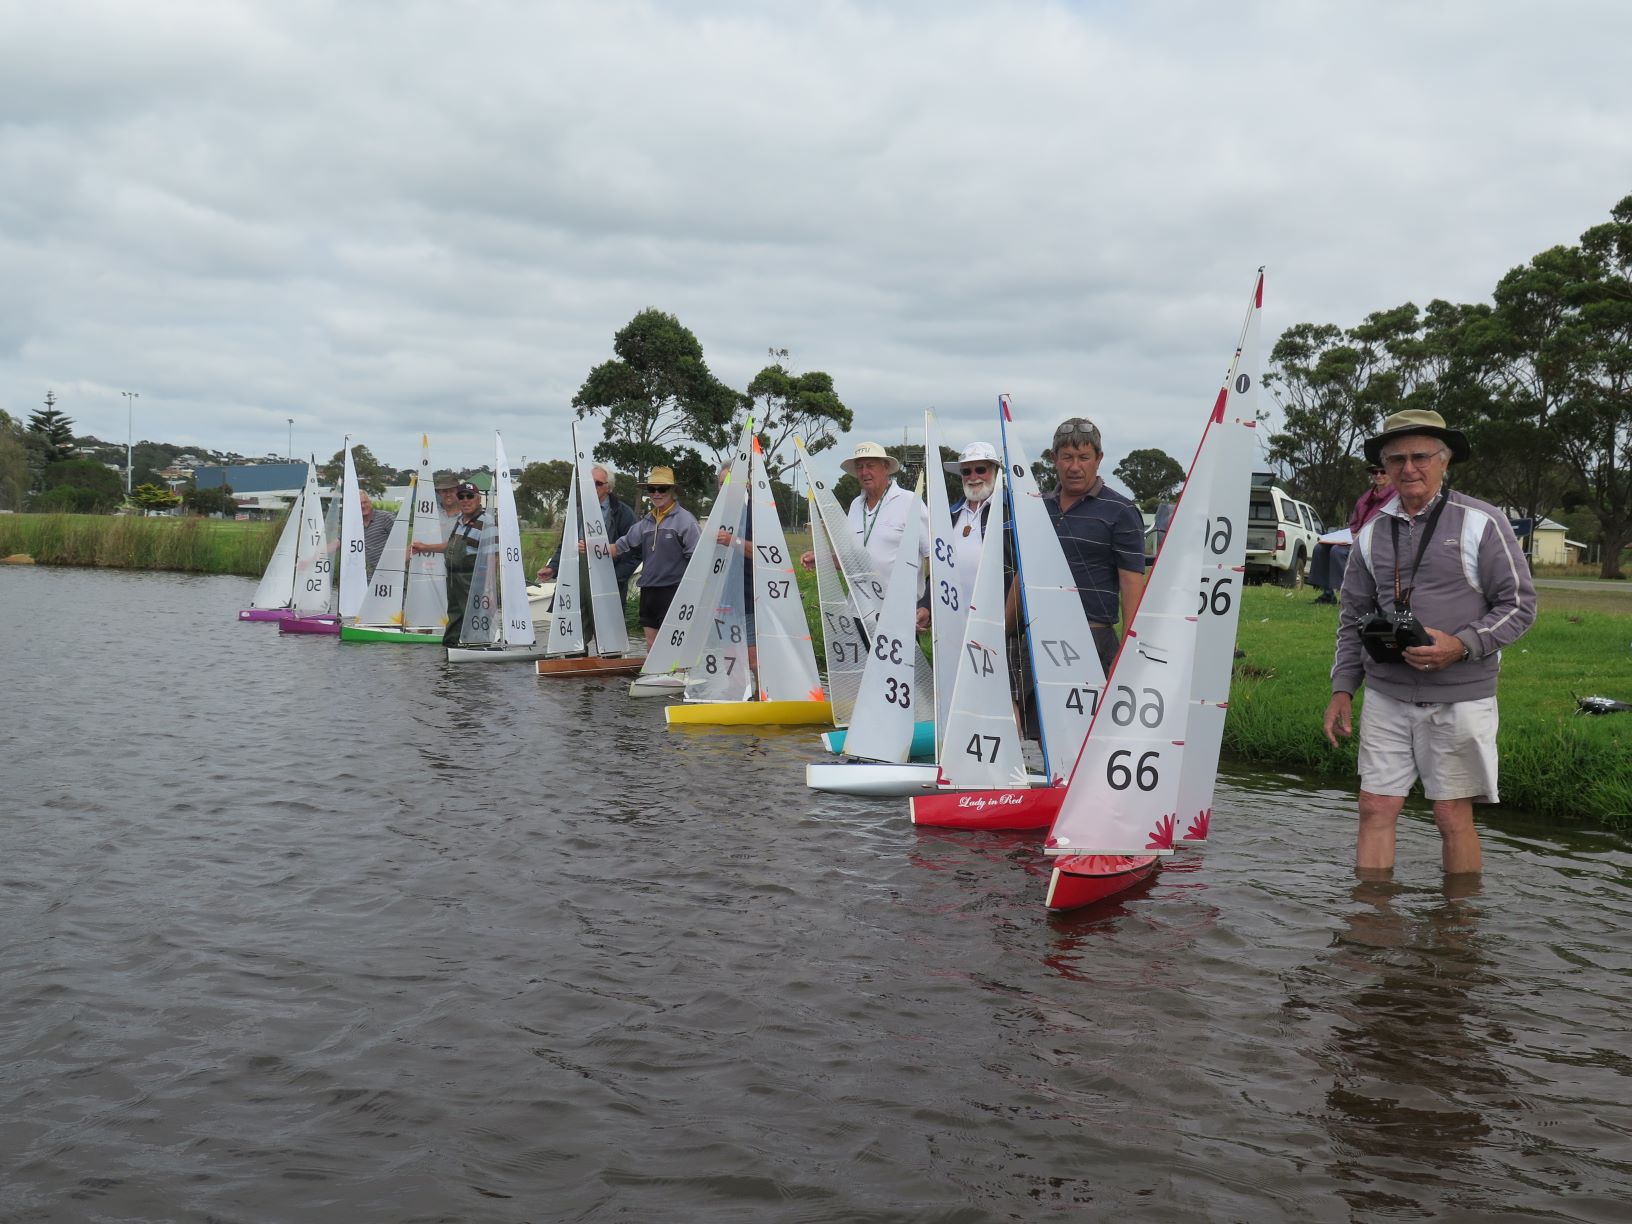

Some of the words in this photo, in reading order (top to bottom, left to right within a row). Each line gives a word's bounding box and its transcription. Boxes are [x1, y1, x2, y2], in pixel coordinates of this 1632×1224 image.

[417, 500, 434, 514] 181
[311, 534, 321, 546] 17
[350, 540, 364, 553] 50
[506, 547, 520, 562] 68
[594, 543, 610, 560] 64
[315, 560, 331, 574] 50
[374, 583, 392, 597] 181
[767, 580, 790, 599] 87
[940, 580, 959, 611] 33
[471, 615, 490, 631] 68
[511, 619, 527, 630] AUS
[560, 620, 573, 636] 64
[670, 629, 685, 647] 66
[832, 641, 859, 664] 97
[705, 654, 737, 676] 87
[885, 677, 911, 709] 33
[1065, 687, 1099, 717] 47
[966, 733, 1001, 764] 47
[1106, 749, 1160, 792] 66
[958, 796, 986, 811] Lady
[999, 793, 1023, 805] Red
